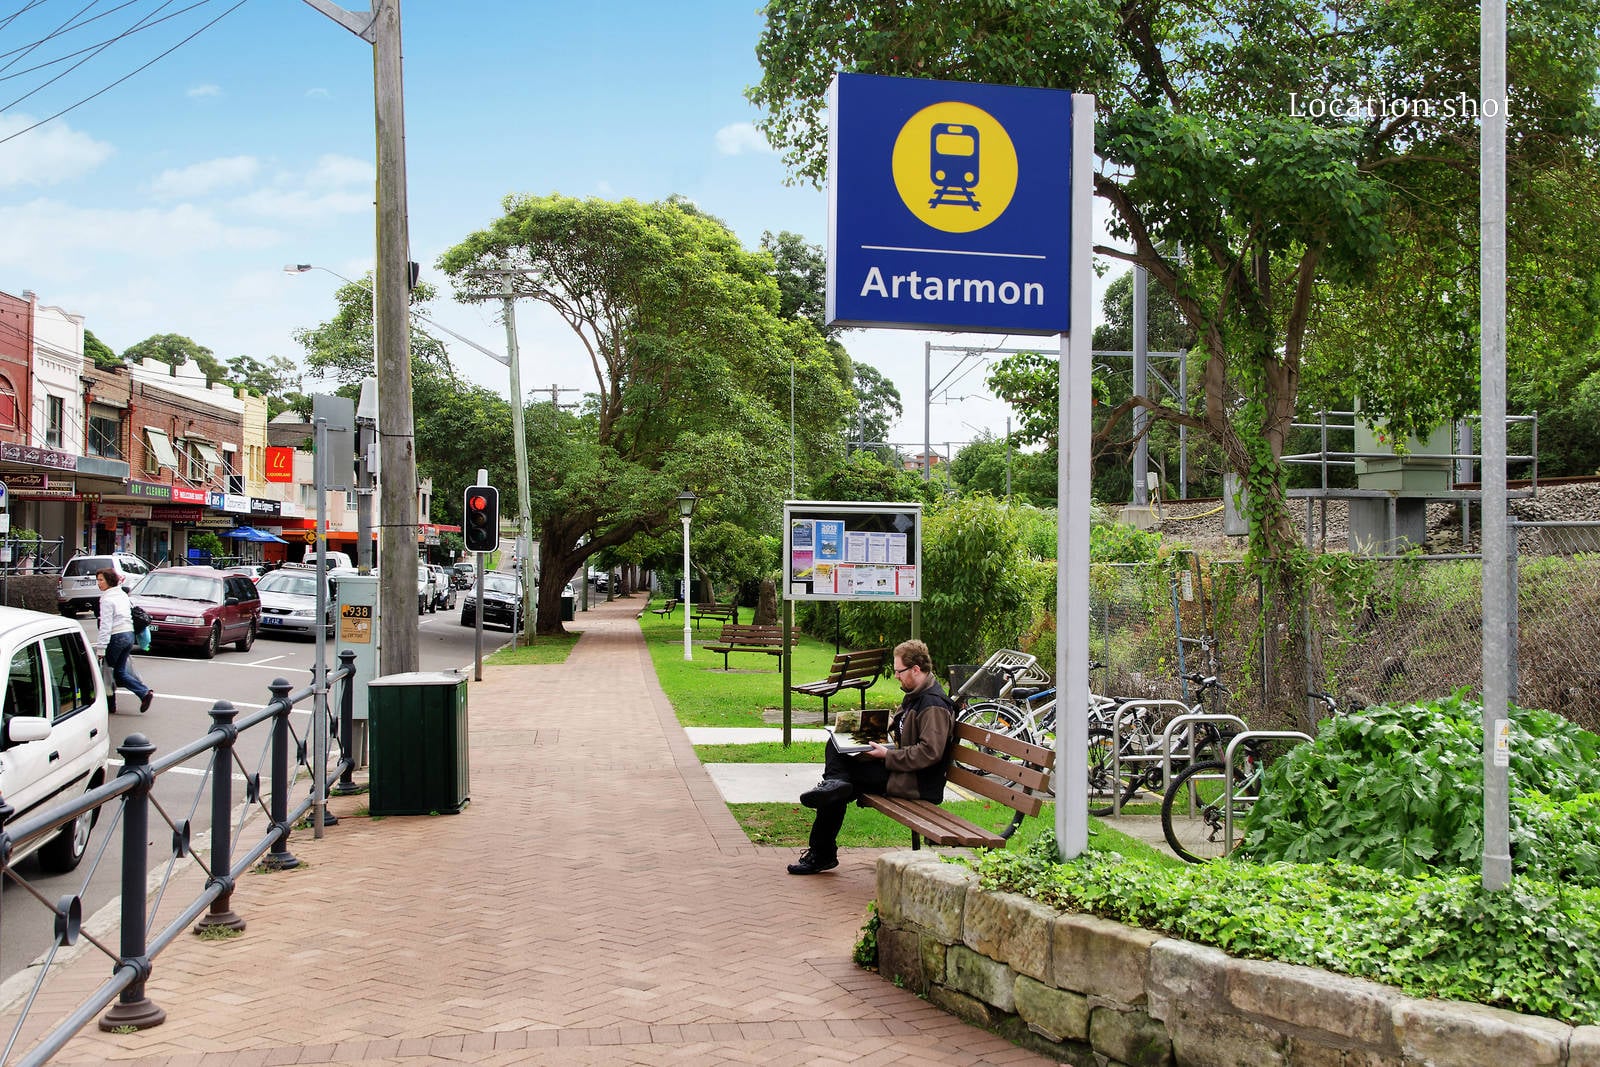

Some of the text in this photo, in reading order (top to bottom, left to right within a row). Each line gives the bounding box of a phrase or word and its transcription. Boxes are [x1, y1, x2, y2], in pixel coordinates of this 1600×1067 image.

[860, 266, 1044, 306] Artarmon
[131, 484, 141, 494] DRY
[146, 486, 169, 497] CLEANERS
